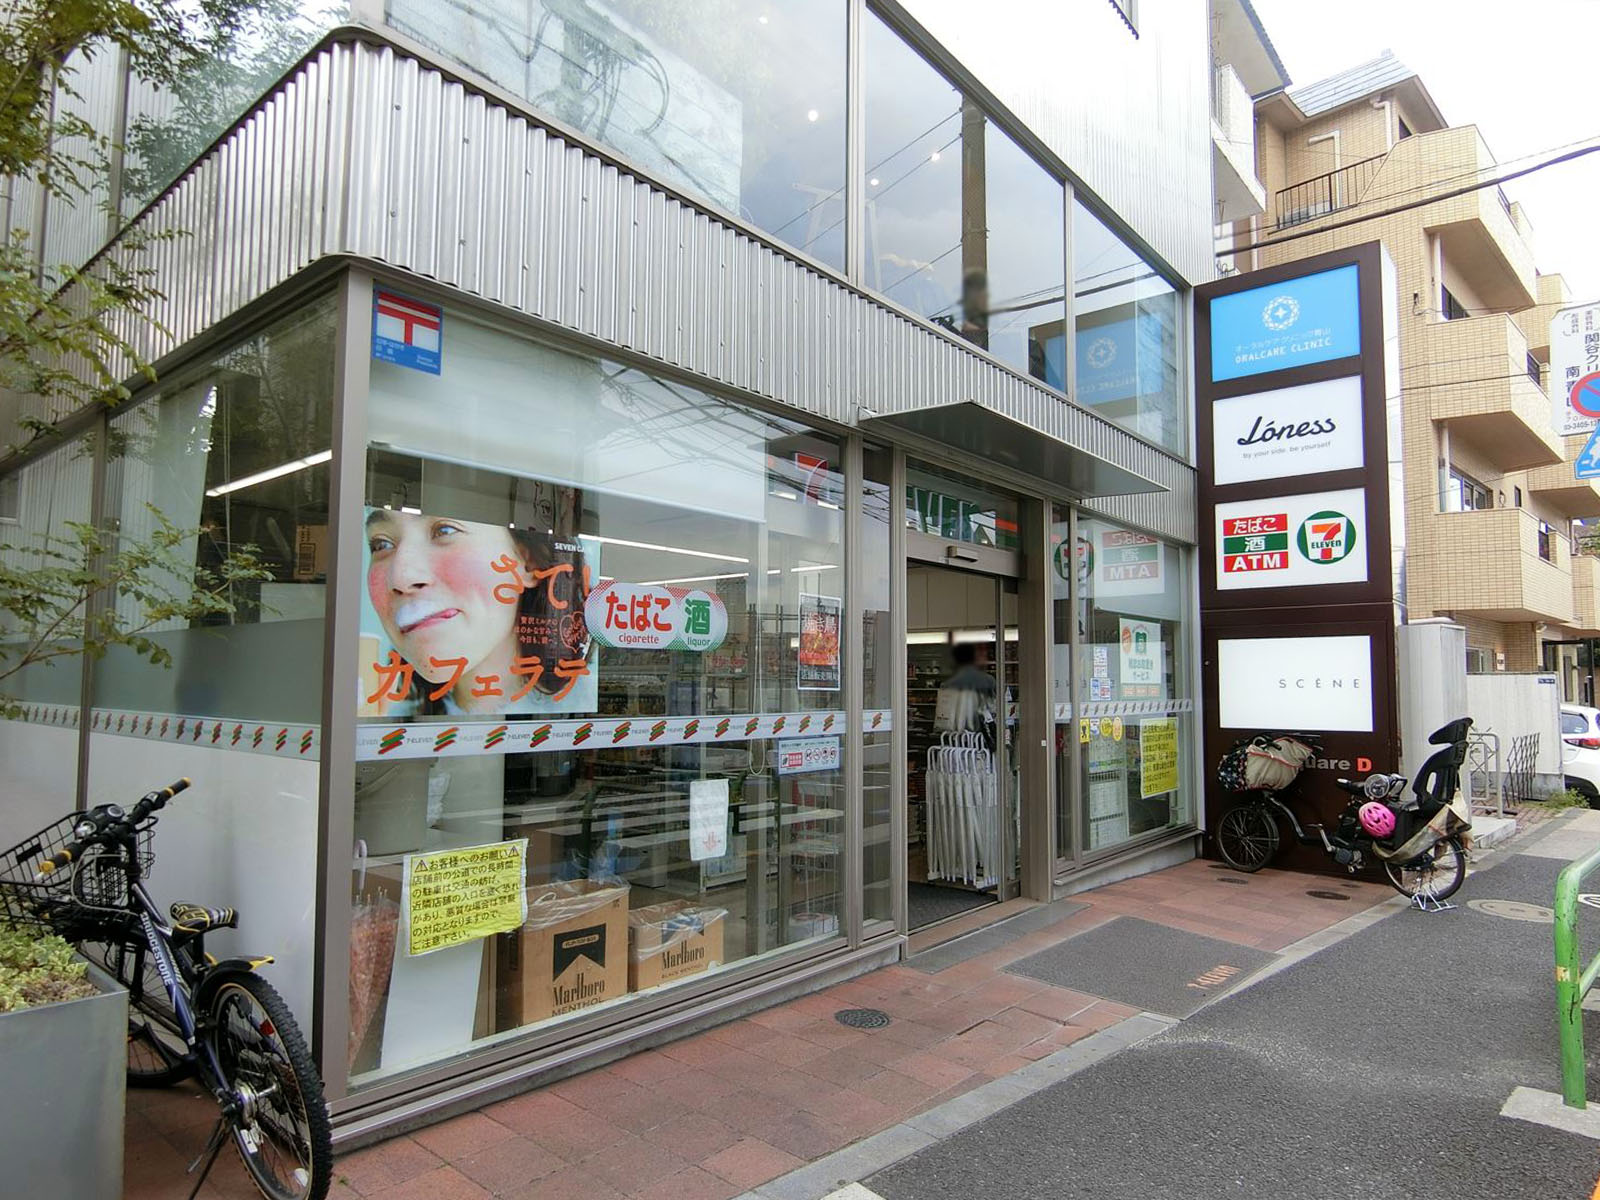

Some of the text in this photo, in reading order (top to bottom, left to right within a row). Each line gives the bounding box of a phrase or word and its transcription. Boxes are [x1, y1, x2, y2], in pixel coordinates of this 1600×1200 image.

[1235, 337, 1333, 364] ORALCARE CLINIC
[1237, 416, 1336, 445] Lóness
[1254, 450, 1269, 458] your
[1301, 440, 1331, 452] yourself
[1232, 517, 1278, 535] たばこ
[554, 542, 576, 552] SEVEN
[1244, 536, 1267, 552] 酒
[1311, 522, 1342, 560] 7
[1231, 553, 1281, 571] ATM
[605, 591, 673, 632] たばこ
[684, 598, 711, 635] 酒
[618, 633, 660, 645] cigarette
[687, 637, 711, 647] liquor
[367, 651, 591, 703] カフェラテ
[1357, 757, 1373, 772] D
[662, 941, 705, 969] Marlboro
[553, 972, 605, 1007] Marlboro
